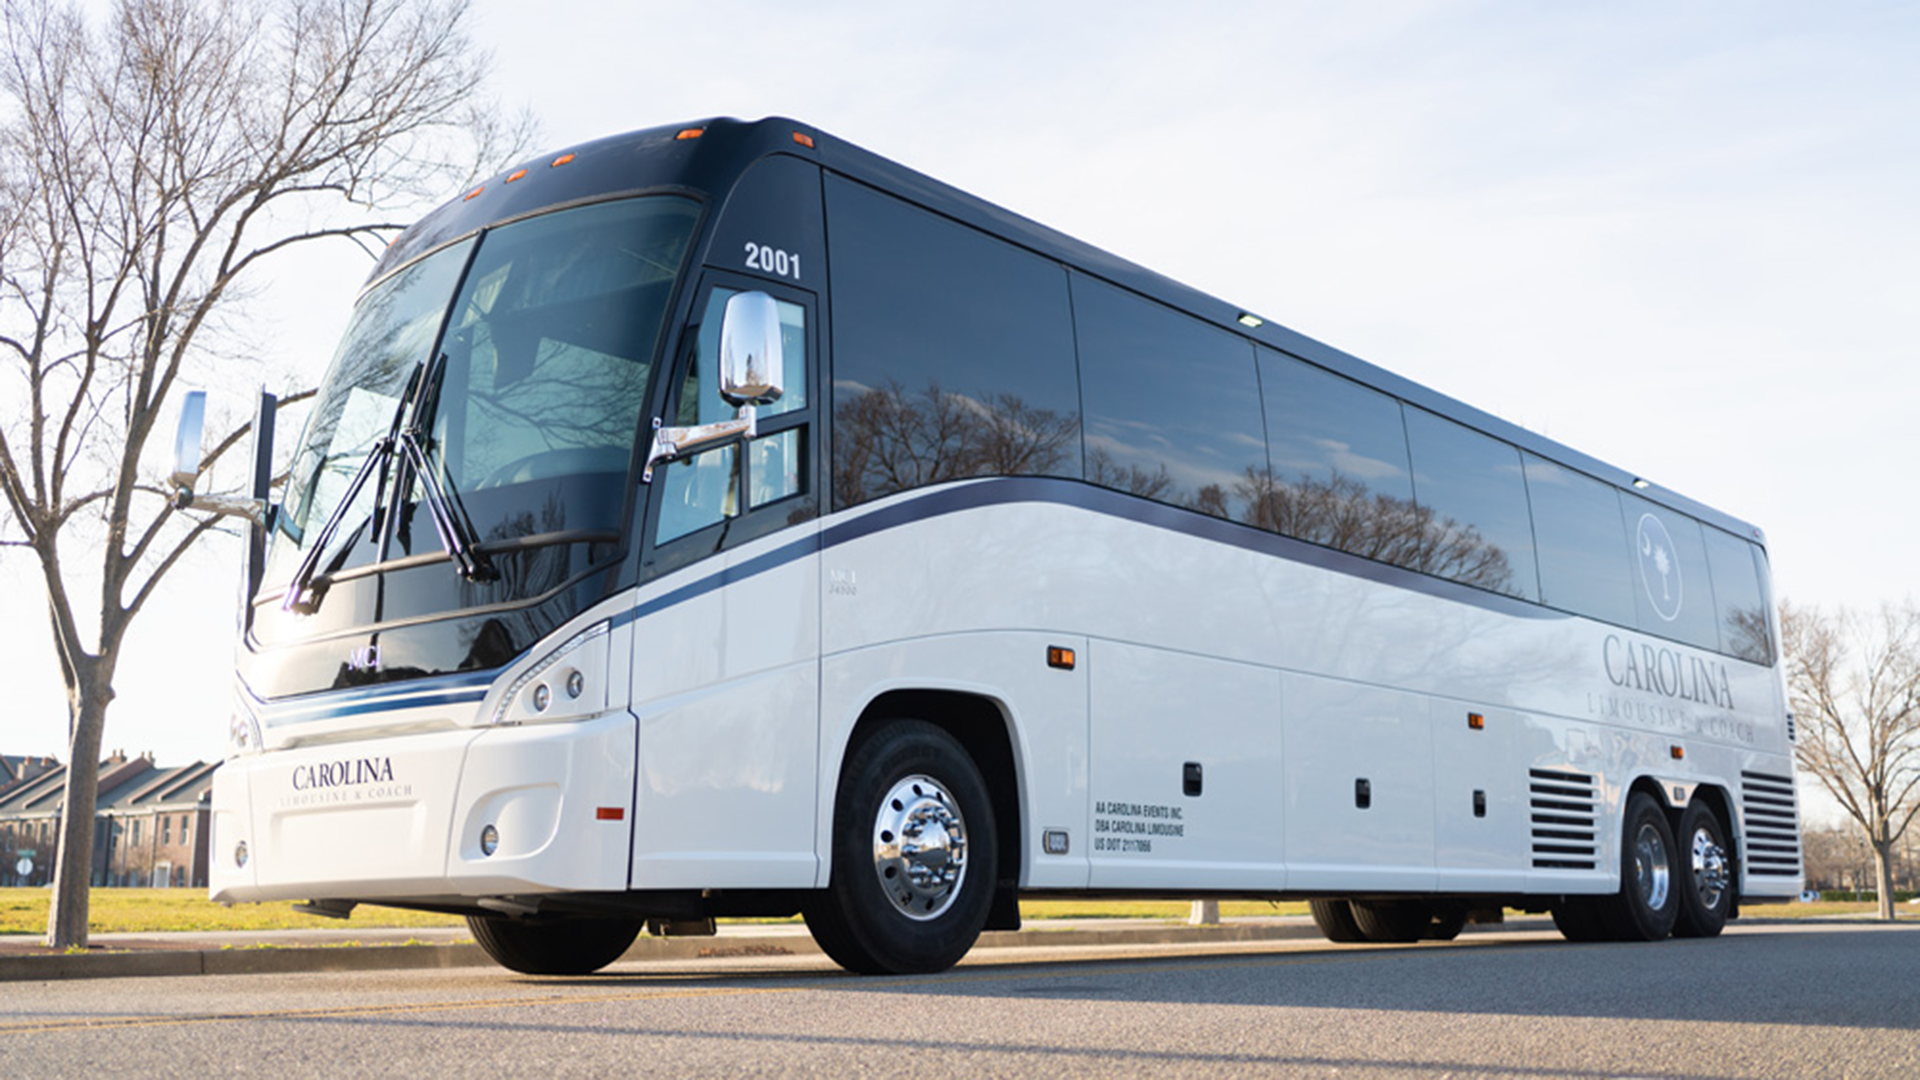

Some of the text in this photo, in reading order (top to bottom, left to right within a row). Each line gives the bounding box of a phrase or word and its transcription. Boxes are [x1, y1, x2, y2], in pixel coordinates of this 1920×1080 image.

[744, 242, 800, 280] 2001
[1603, 634, 1735, 710] CAROLINA
[1586, 692, 1687, 731] LIMOUSINE
[1709, 717, 1754, 743] COACH
[292, 757, 394, 791] CAROLINA
[280, 791, 347, 807] LIMOUSINE
[368, 784, 412, 798] COACH
[1095, 801, 1105, 814] AA
[1107, 802, 1141, 816] CAROLINA
[1143, 804, 1169, 819] EVENTS
[1095, 819, 1184, 837] DBA CAROLINA LIMOUSINE
[1094, 837, 1105, 851] US
[1106, 837, 1120, 851] DOT
